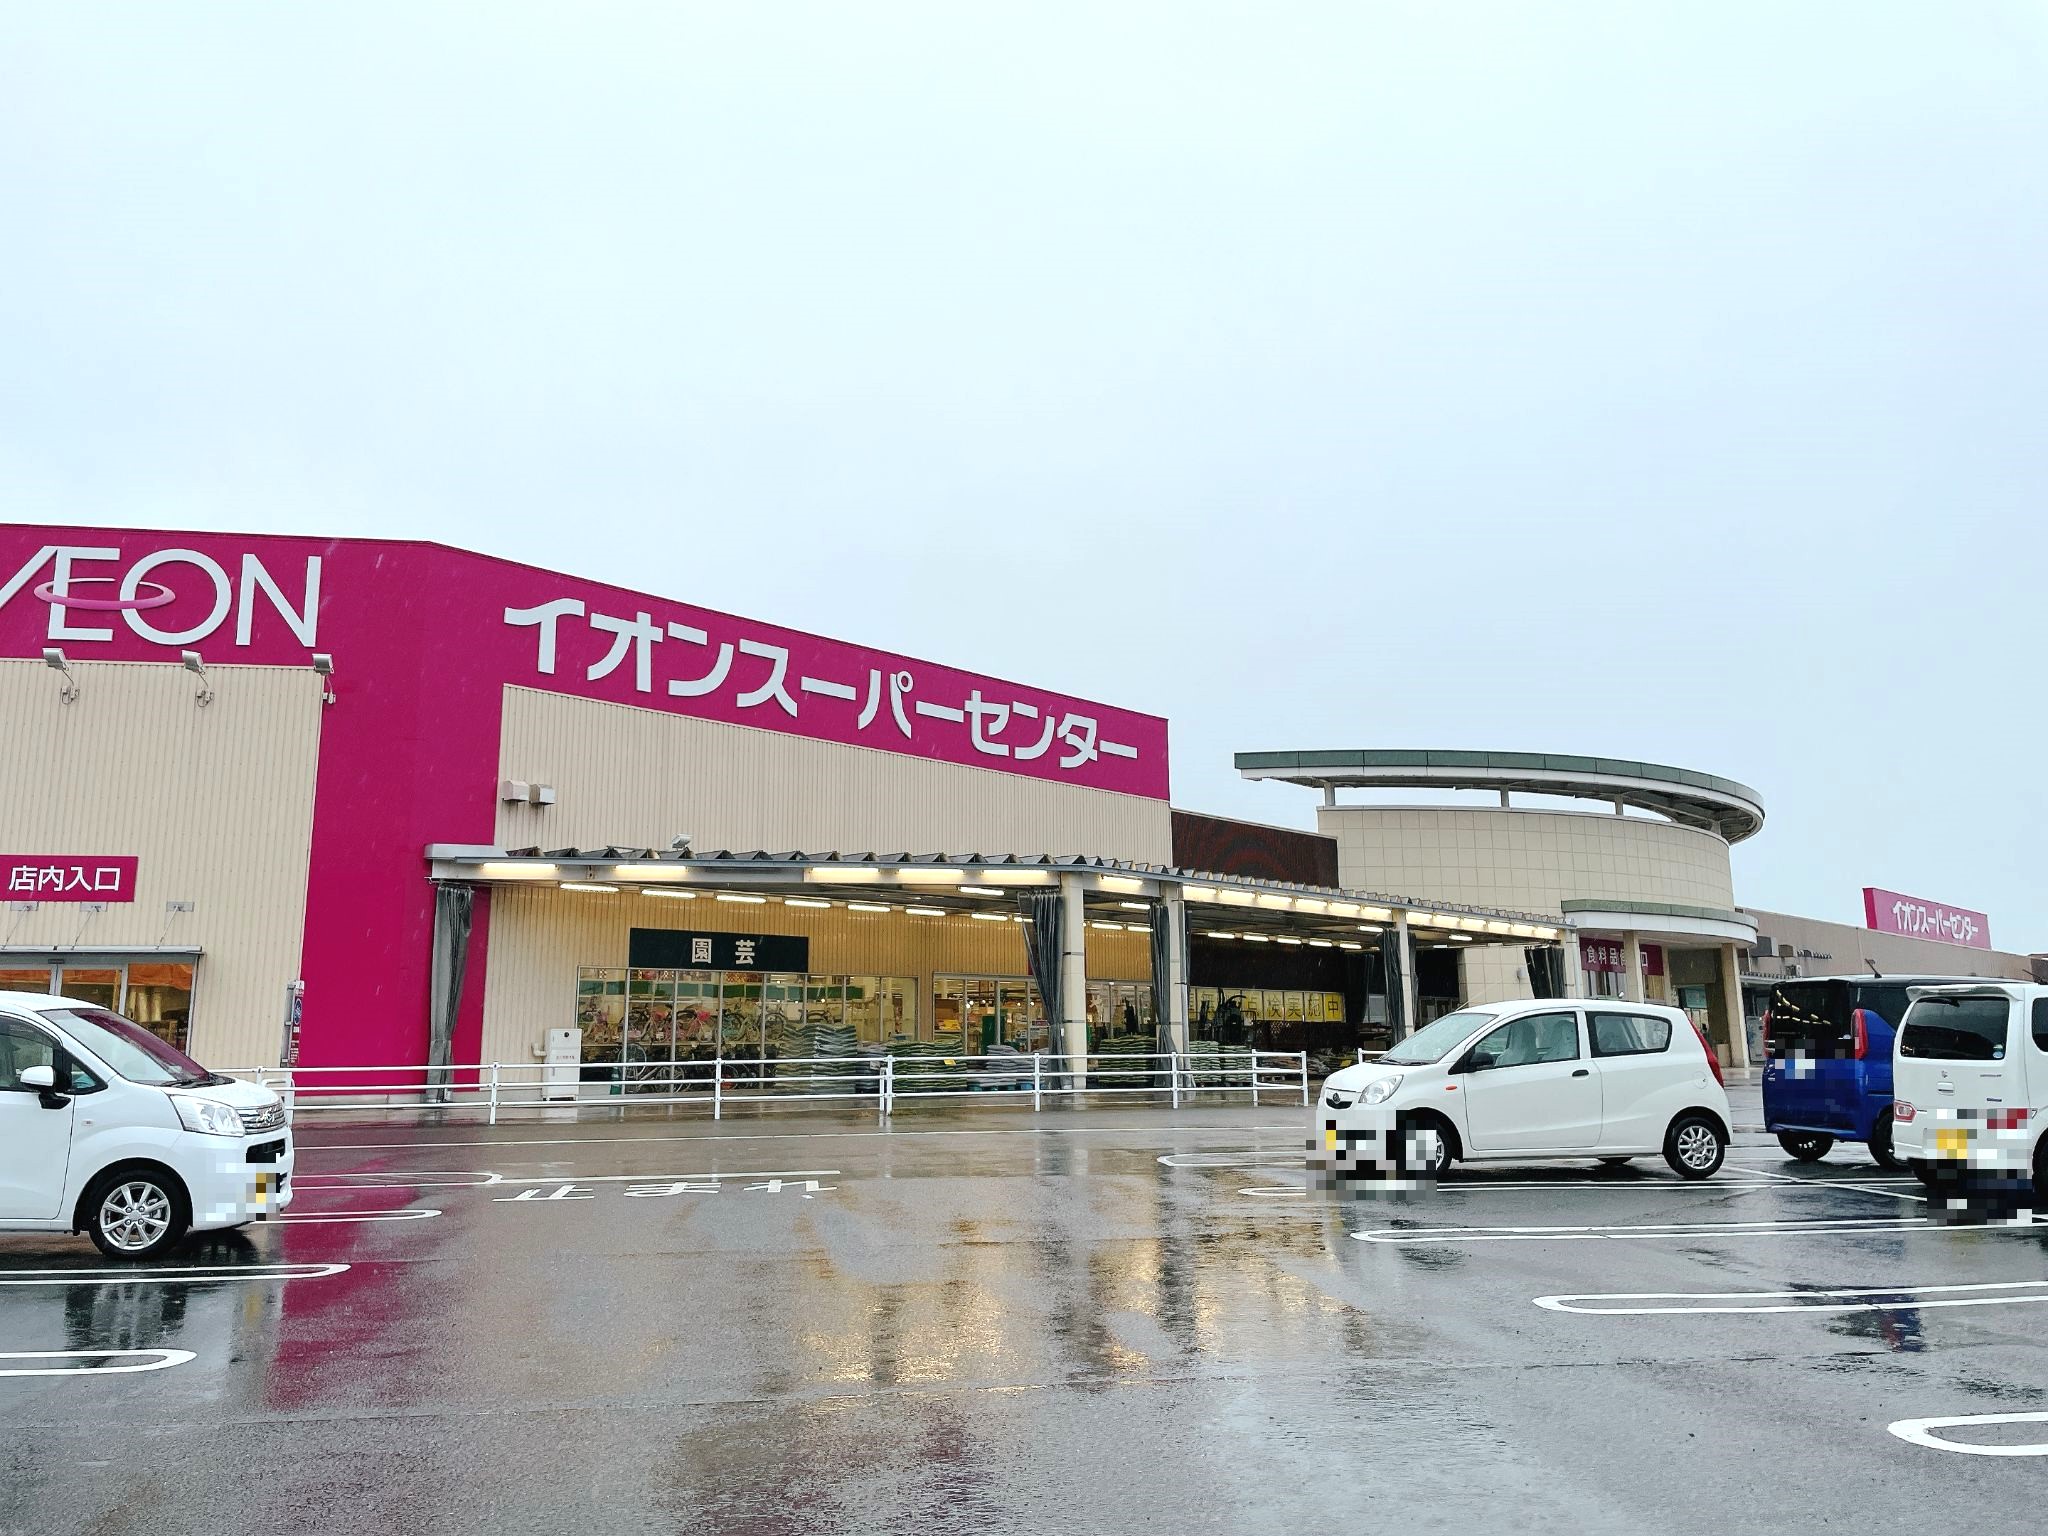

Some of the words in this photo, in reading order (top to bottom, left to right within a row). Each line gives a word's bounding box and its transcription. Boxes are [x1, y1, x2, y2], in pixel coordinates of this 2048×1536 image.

[504, 598, 1138, 768] イオンスーパーセンター
[8, 865, 121, 891] 店内入口
[1893, 900, 1978, 941] イオンスーパーセンター
[692, 938, 755, 965] 園芸
[1587, 945, 1649, 968] 食料品口
[493, 1179, 838, 1202] 止まれ
